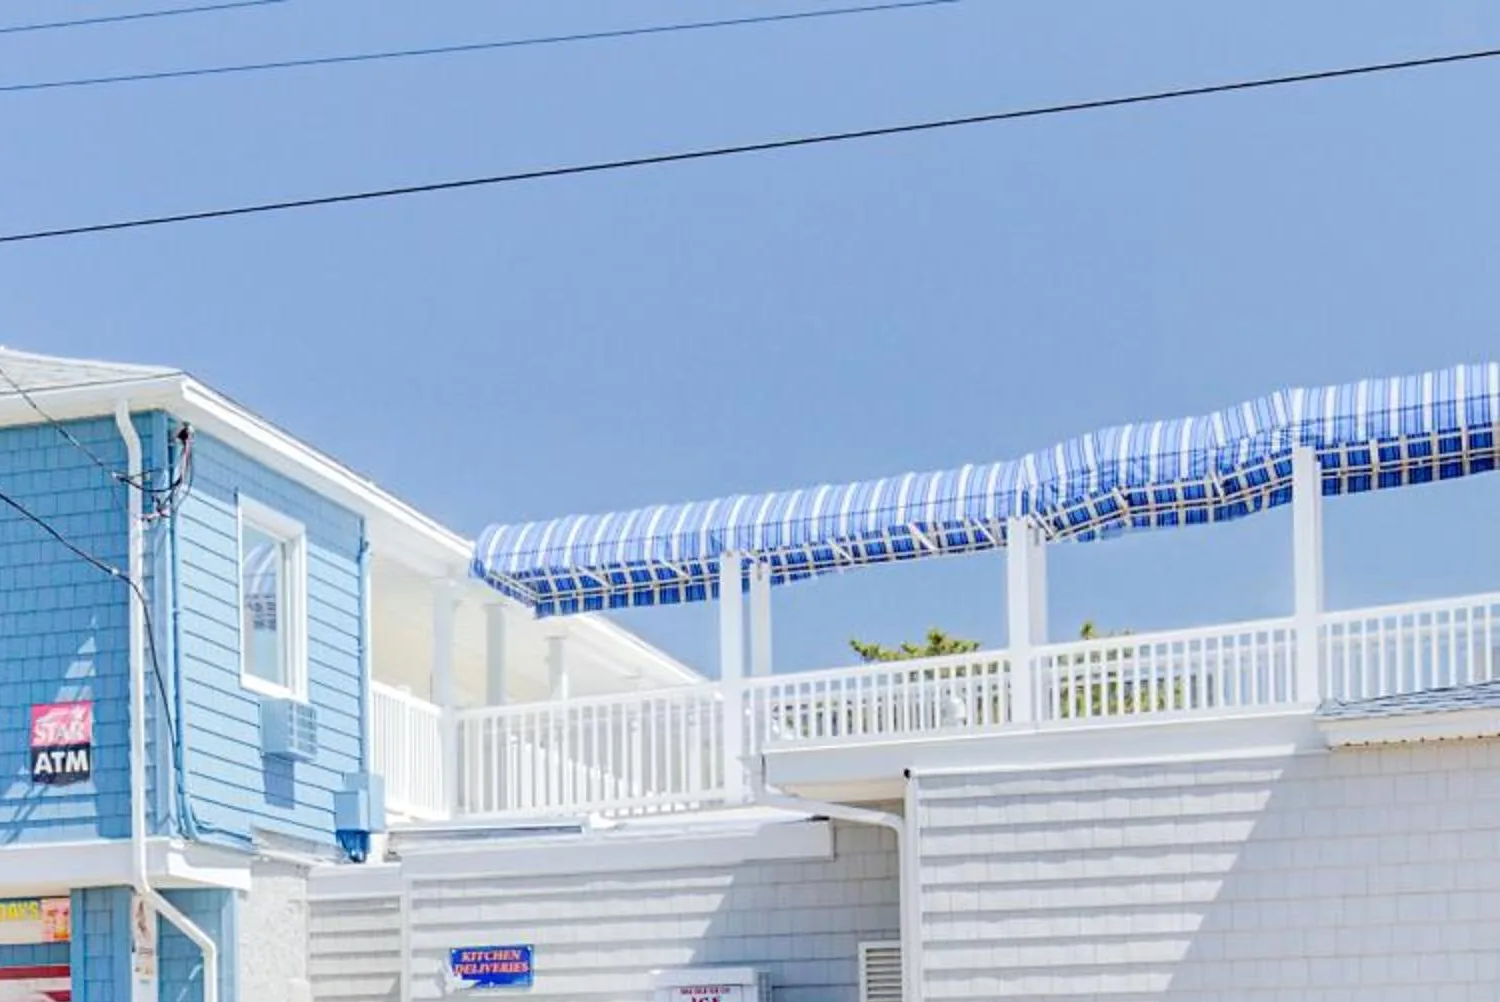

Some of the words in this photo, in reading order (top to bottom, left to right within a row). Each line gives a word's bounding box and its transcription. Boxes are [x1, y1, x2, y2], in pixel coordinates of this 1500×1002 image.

[33, 749, 89, 775] ATM
[461, 950, 519, 961] KITCHEN
[452, 961, 529, 976] DELIVERIES
